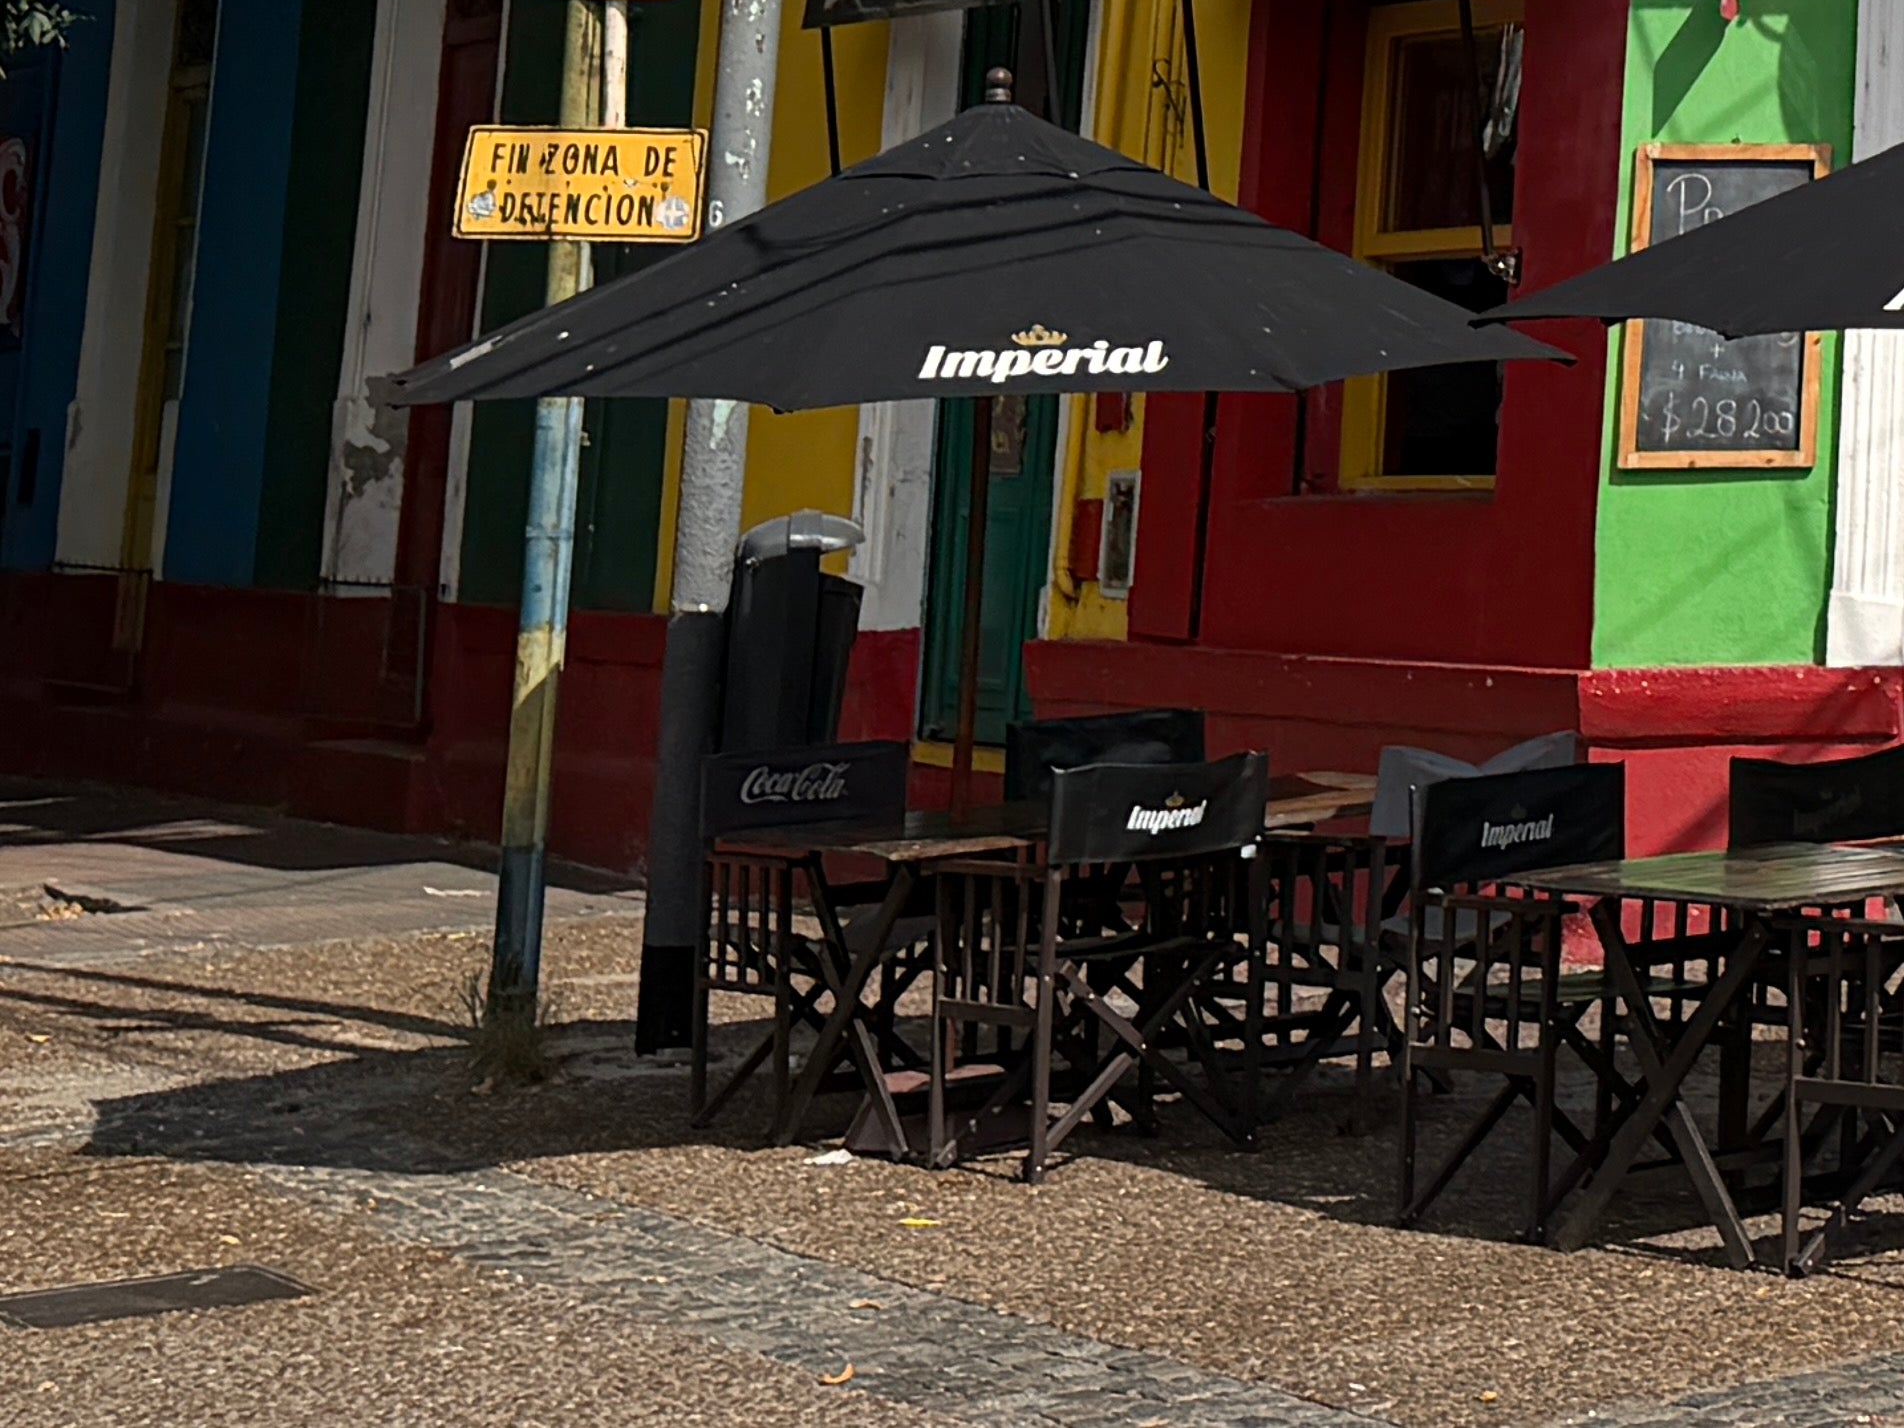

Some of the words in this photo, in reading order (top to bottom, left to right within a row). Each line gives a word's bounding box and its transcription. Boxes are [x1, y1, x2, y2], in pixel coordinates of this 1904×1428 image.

[491, 143, 530, 174] FIN
[543, 143, 619, 176] ZONA
[643, 146, 678, 177] DE
[918, 340, 1169, 383] Imperial
